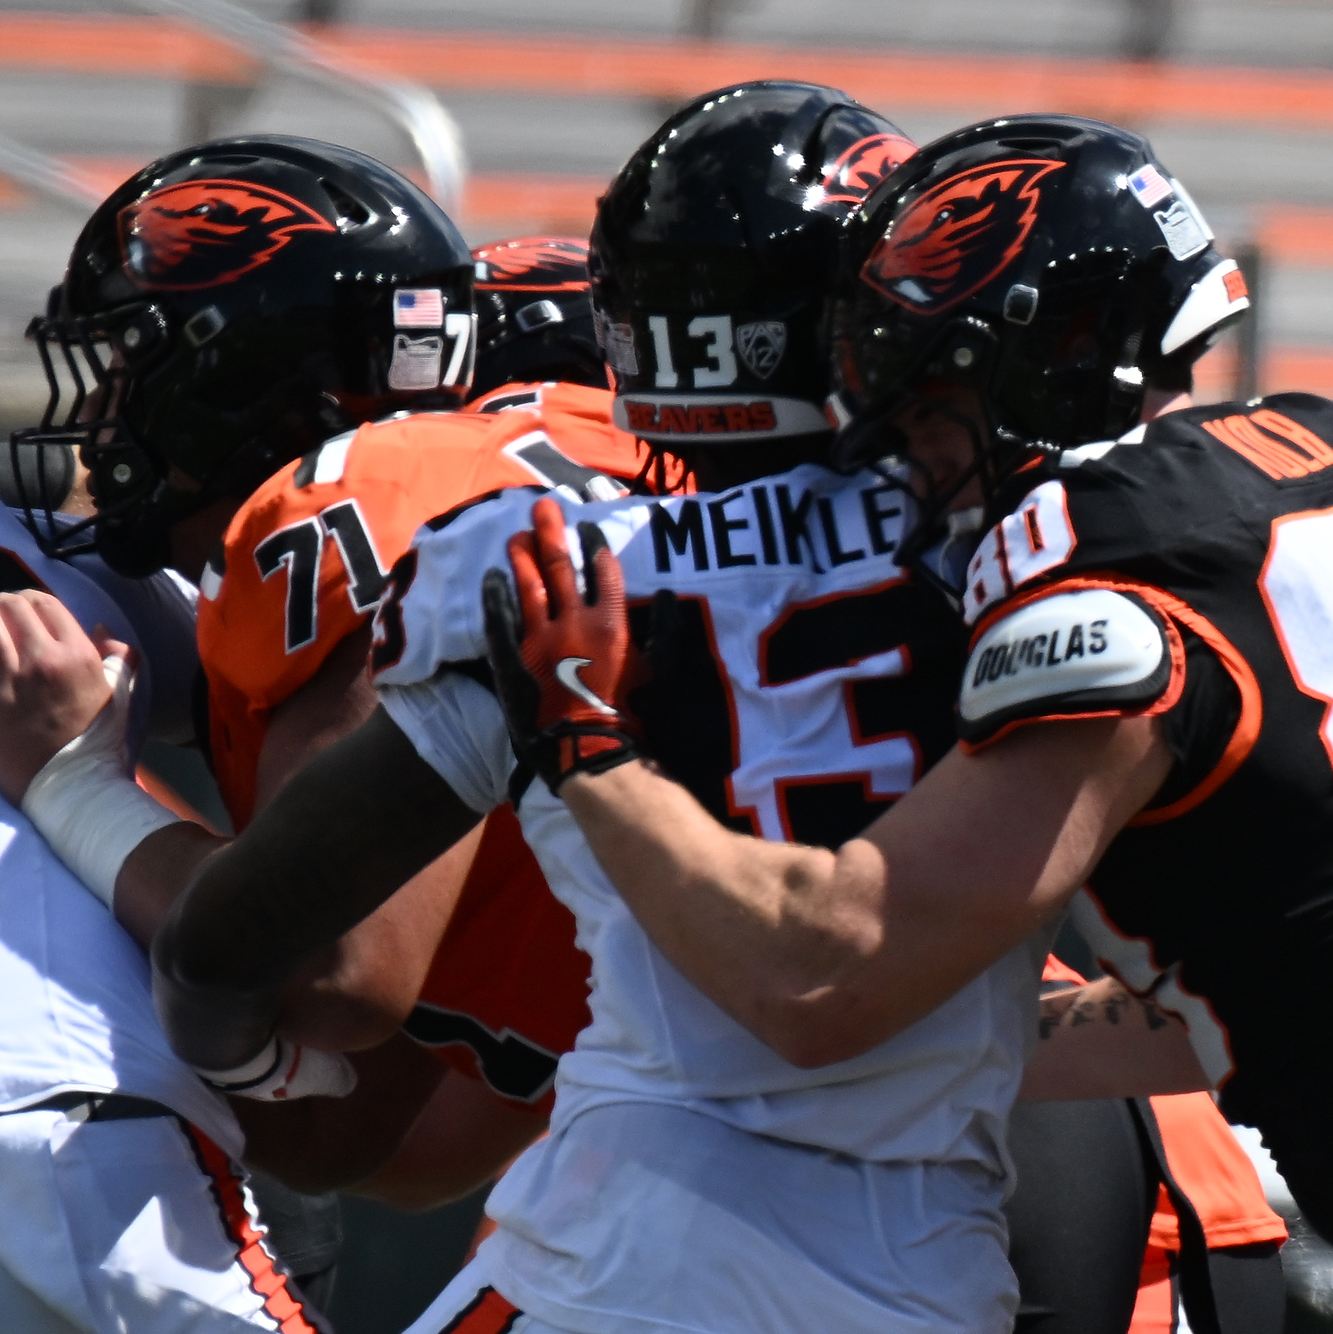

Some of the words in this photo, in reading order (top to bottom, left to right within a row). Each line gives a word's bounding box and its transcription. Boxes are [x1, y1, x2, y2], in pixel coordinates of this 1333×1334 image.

[648, 315, 738, 388] 13
[624, 400, 777, 433] BEAVERS
[254, 498, 386, 650] 71
[963, 479, 1079, 627] 80
[973, 619, 1109, 689] DOUGLAS
